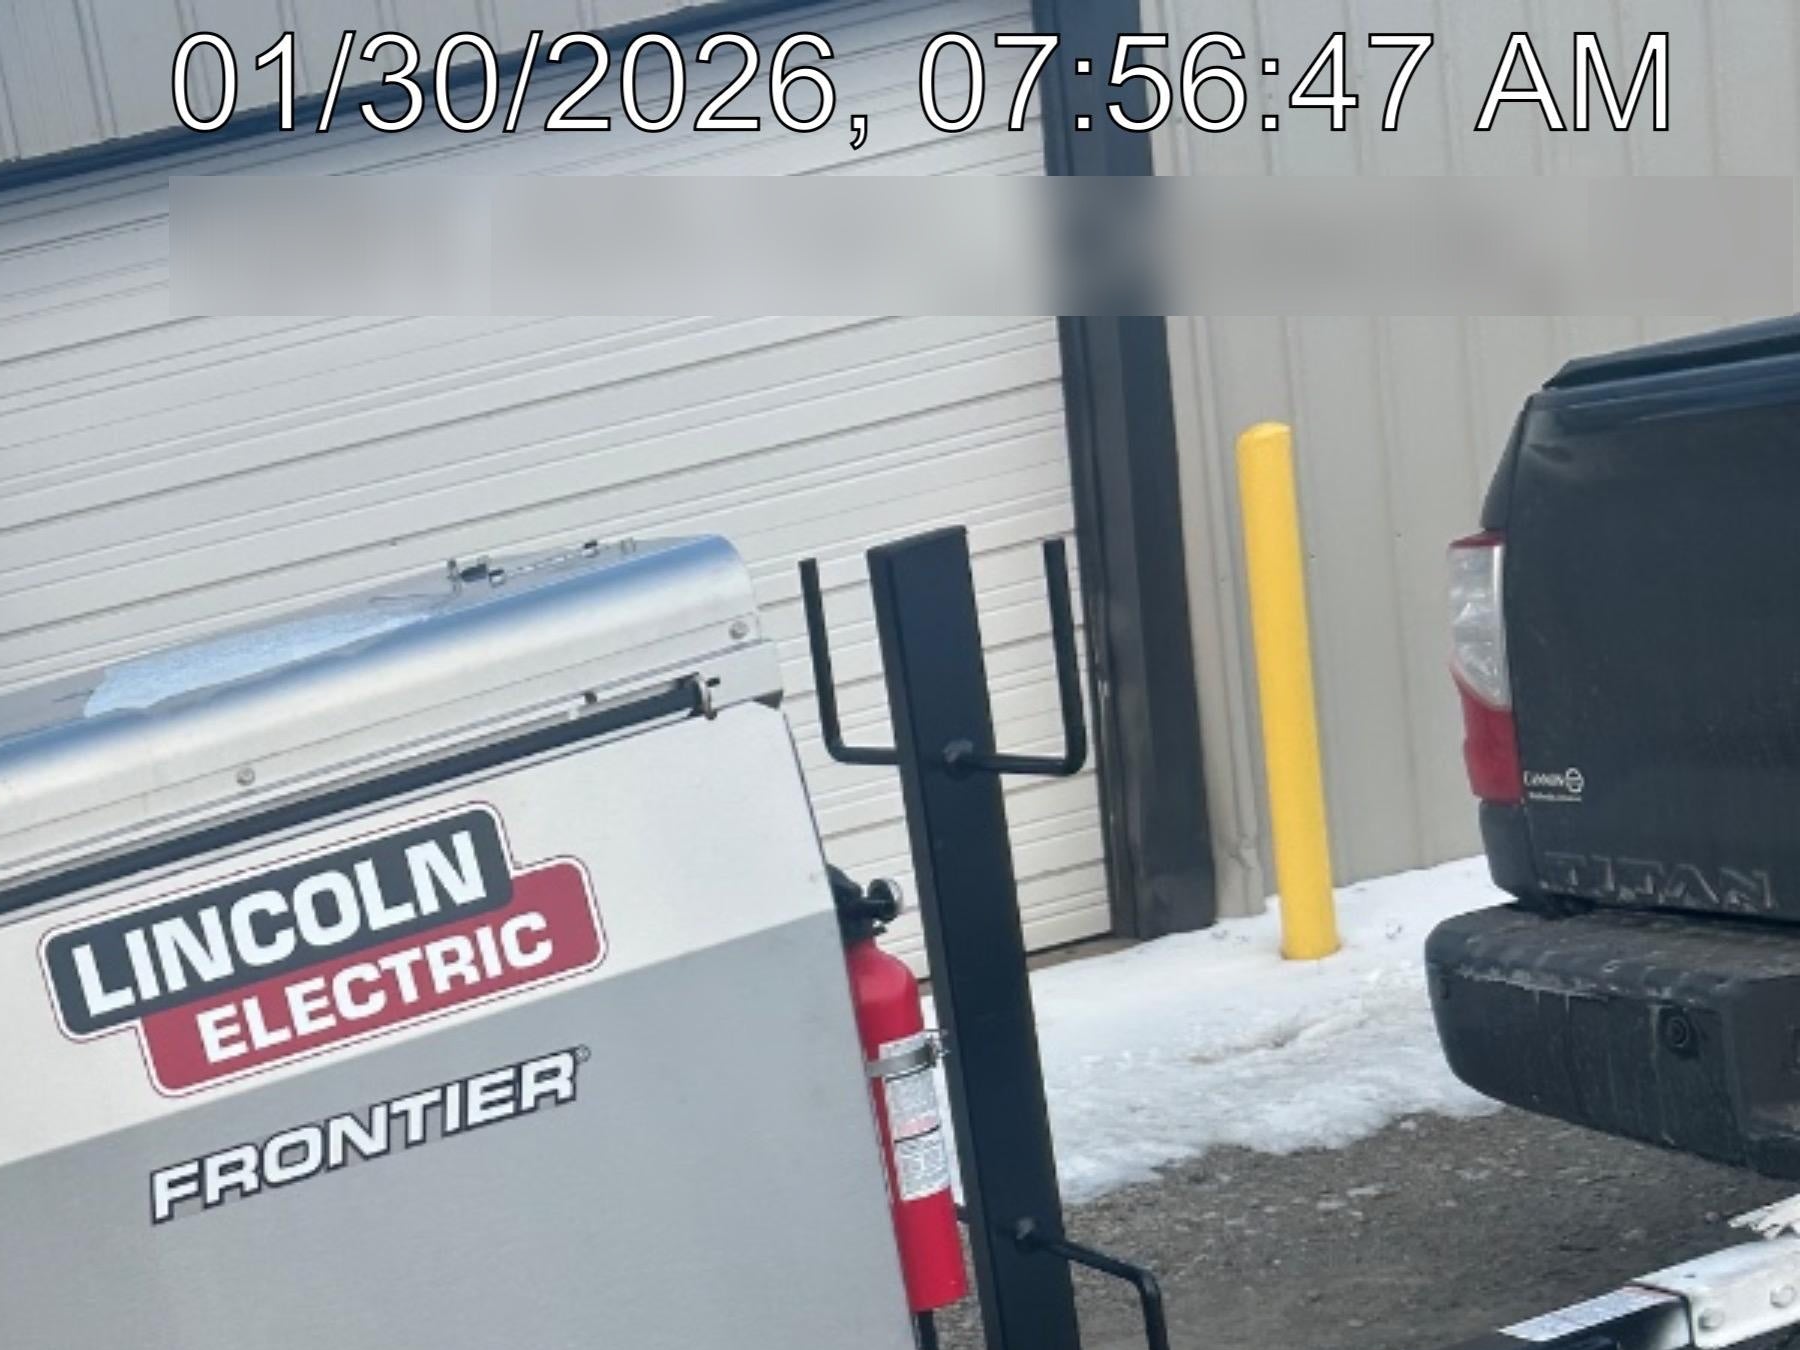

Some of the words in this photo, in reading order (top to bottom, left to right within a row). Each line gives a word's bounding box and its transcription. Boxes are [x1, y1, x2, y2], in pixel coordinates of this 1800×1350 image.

[72, 831, 488, 1018] LINCOLN
[1540, 850, 1772, 910] TITAN
[195, 911, 553, 1065] ELECTRIC
[150, 1047, 580, 1226] FRONTIER
